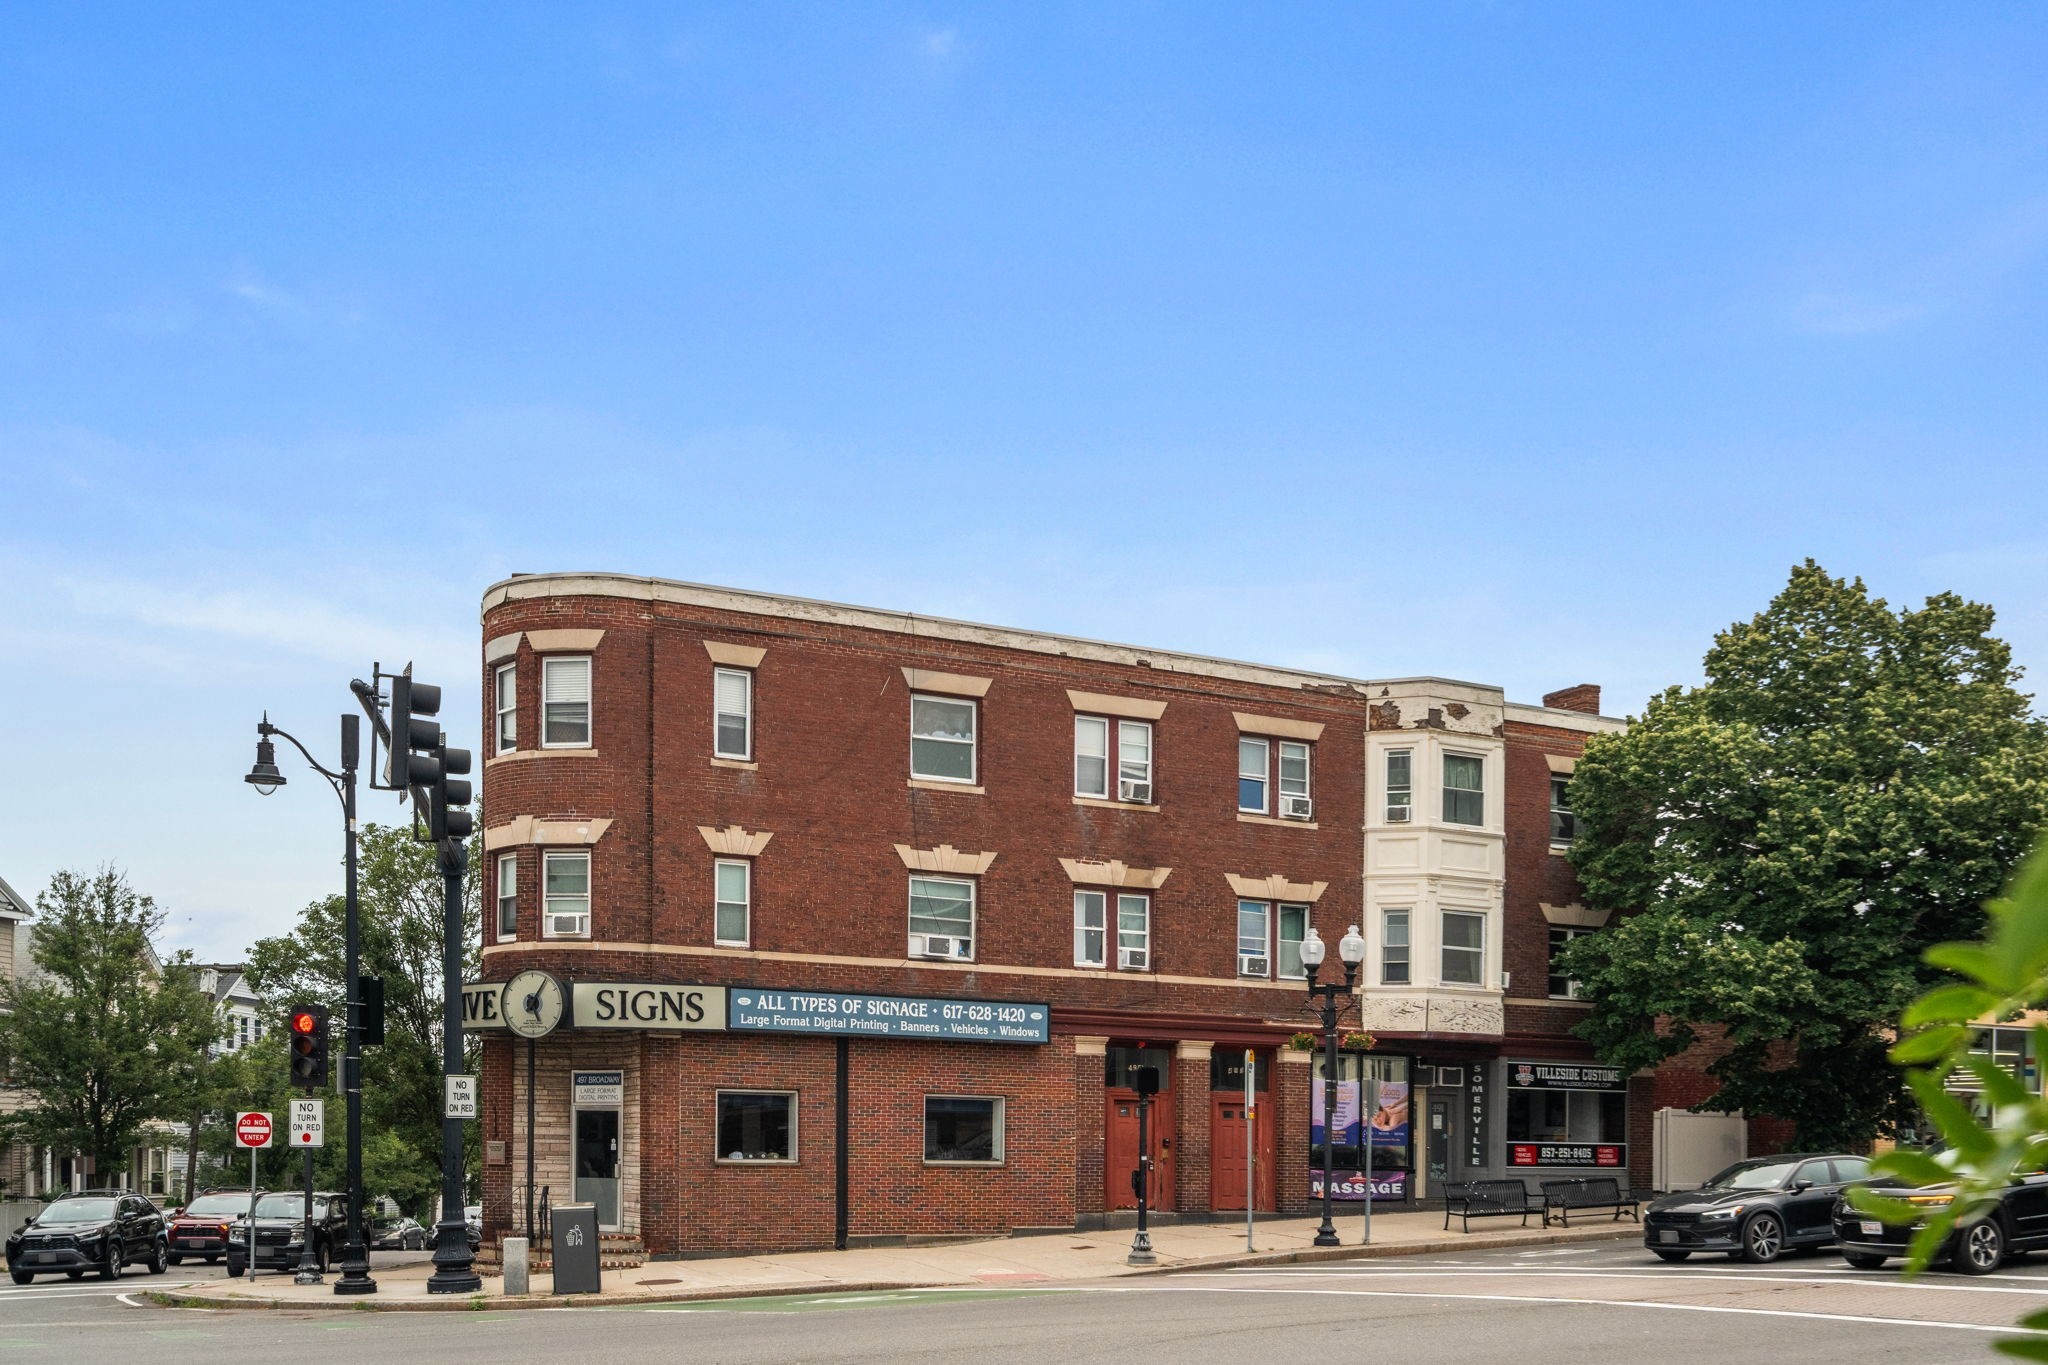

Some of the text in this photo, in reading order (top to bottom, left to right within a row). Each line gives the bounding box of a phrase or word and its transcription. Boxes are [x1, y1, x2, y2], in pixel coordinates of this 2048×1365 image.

[597, 990, 704, 1022] SIGNS
[758, 995, 785, 1011] ALL
[790, 996, 836, 1014] TYPES
[842, 999, 862, 1014] OF
[867, 1000, 928, 1018] SIGNAGE
[943, 1004, 1026, 1022] 617-628-1420
[740, 1013, 1039, 1038] Large Format Digital Printing Banners Vehicles Windows
[1536, 1066, 1580, 1080] VILLESIDE
[1582, 1069, 1620, 1082] CUSTOMS
[456, 1080, 467, 1090] NO
[588, 1076, 620, 1084] BROADWAY
[300, 1104, 314, 1112] NO
[449, 1104, 473, 1113] ON RED
[297, 1114, 317, 1122] TURN
[1472, 1065, 1484, 1165] SOMERVILLE
[1542, 1147, 1592, 1158] 857-251-8405
